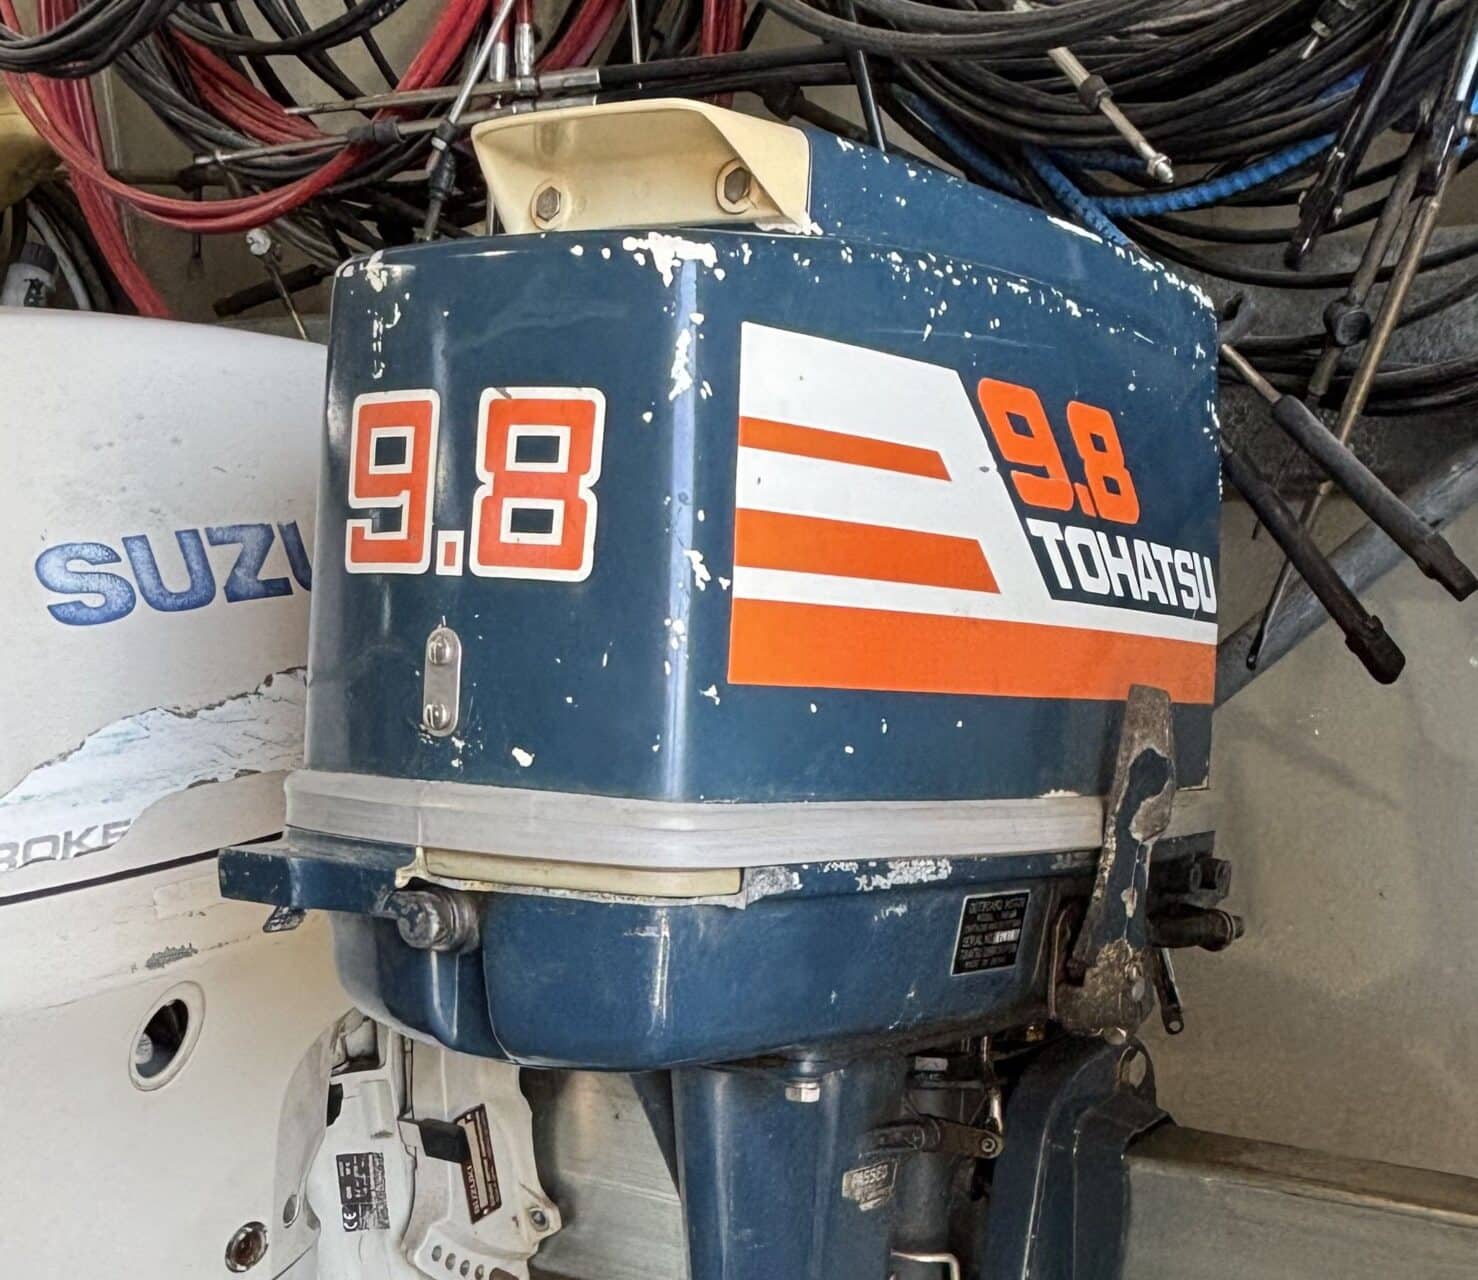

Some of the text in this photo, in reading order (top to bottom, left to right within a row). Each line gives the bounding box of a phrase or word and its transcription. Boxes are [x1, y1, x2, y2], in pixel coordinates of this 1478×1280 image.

[345, 386, 606, 583] 9.8
[978, 377, 1140, 524] 9.8
[1025, 517, 1217, 614] TOHATSU
